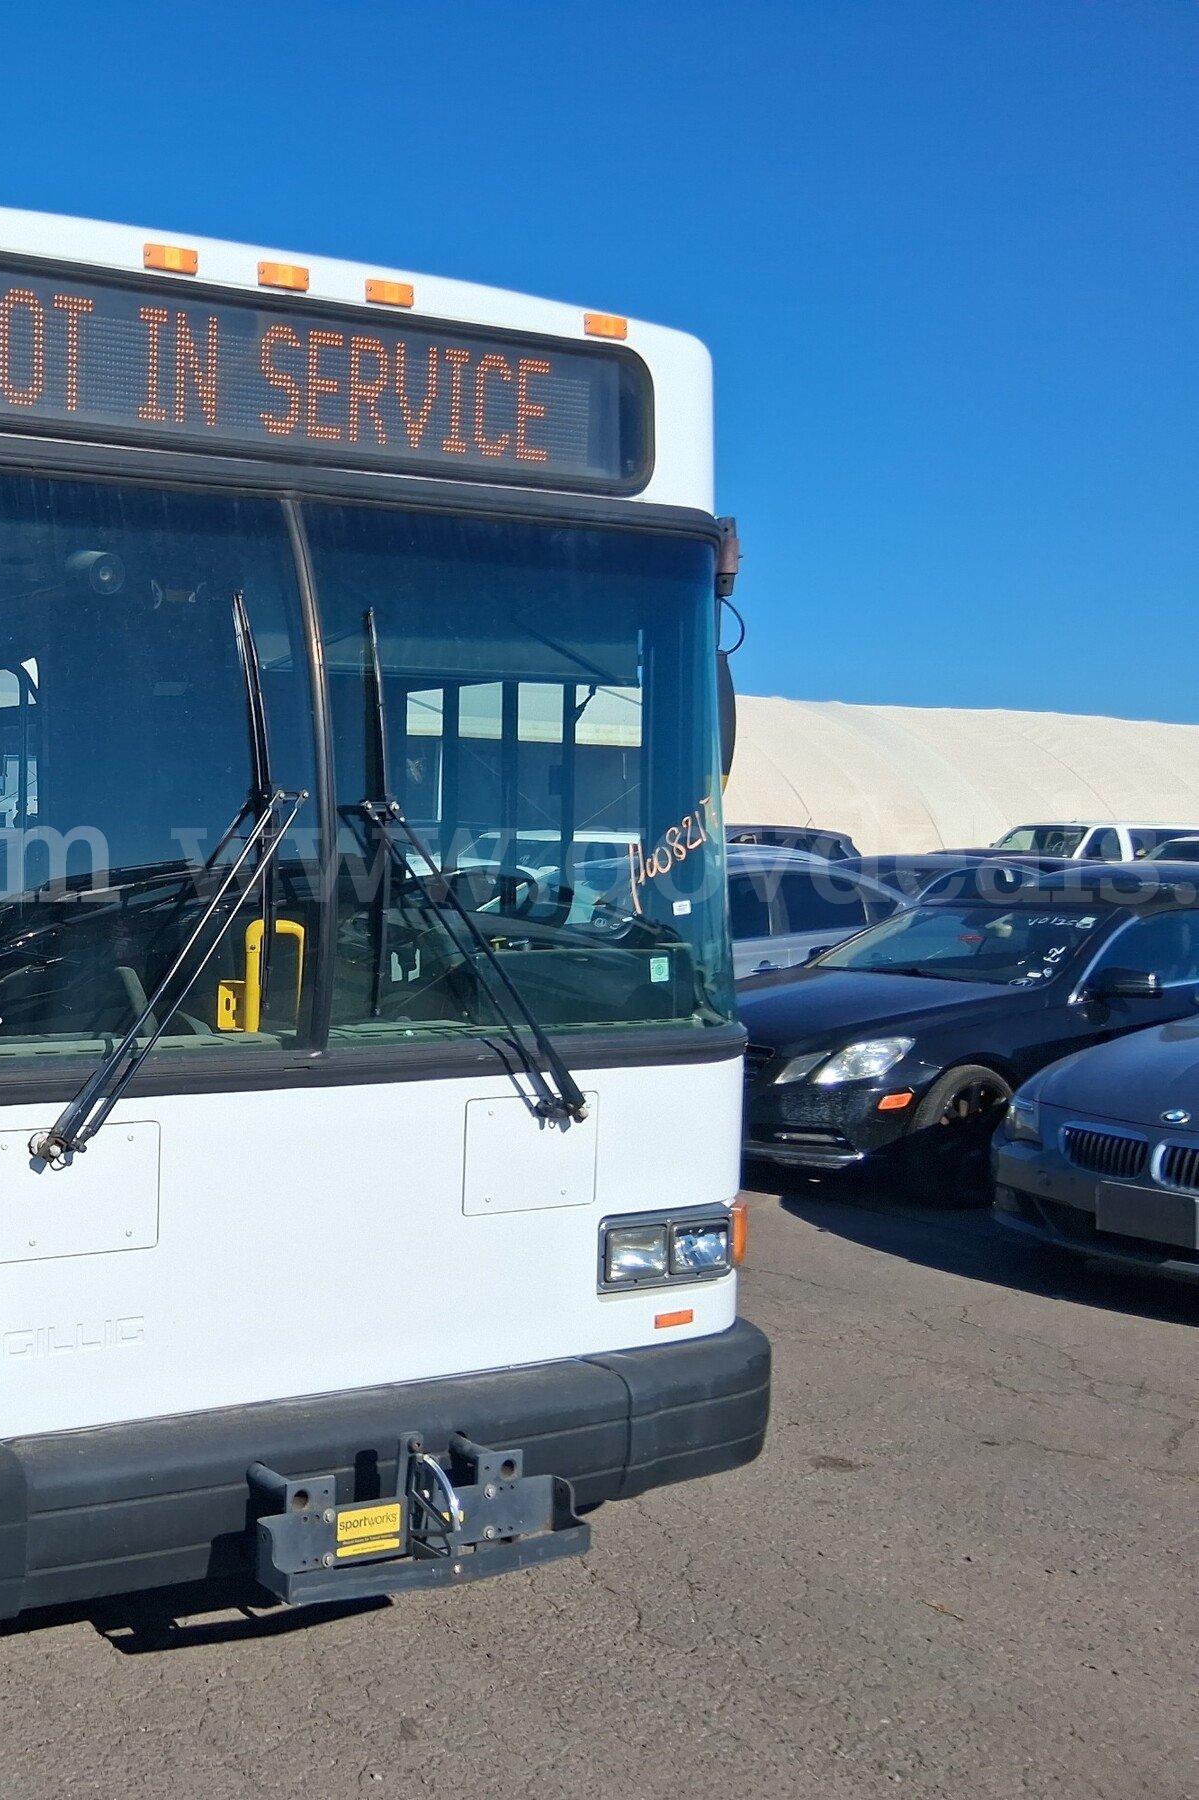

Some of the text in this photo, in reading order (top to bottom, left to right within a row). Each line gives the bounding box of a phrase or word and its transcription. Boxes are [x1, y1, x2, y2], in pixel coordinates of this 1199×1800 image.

[138, 307, 218, 427] IN
[258, 325, 553, 462] SERVICE
[3, 1316, 145, 1360] GILLIG
[339, 1512, 397, 1532] sportworks
